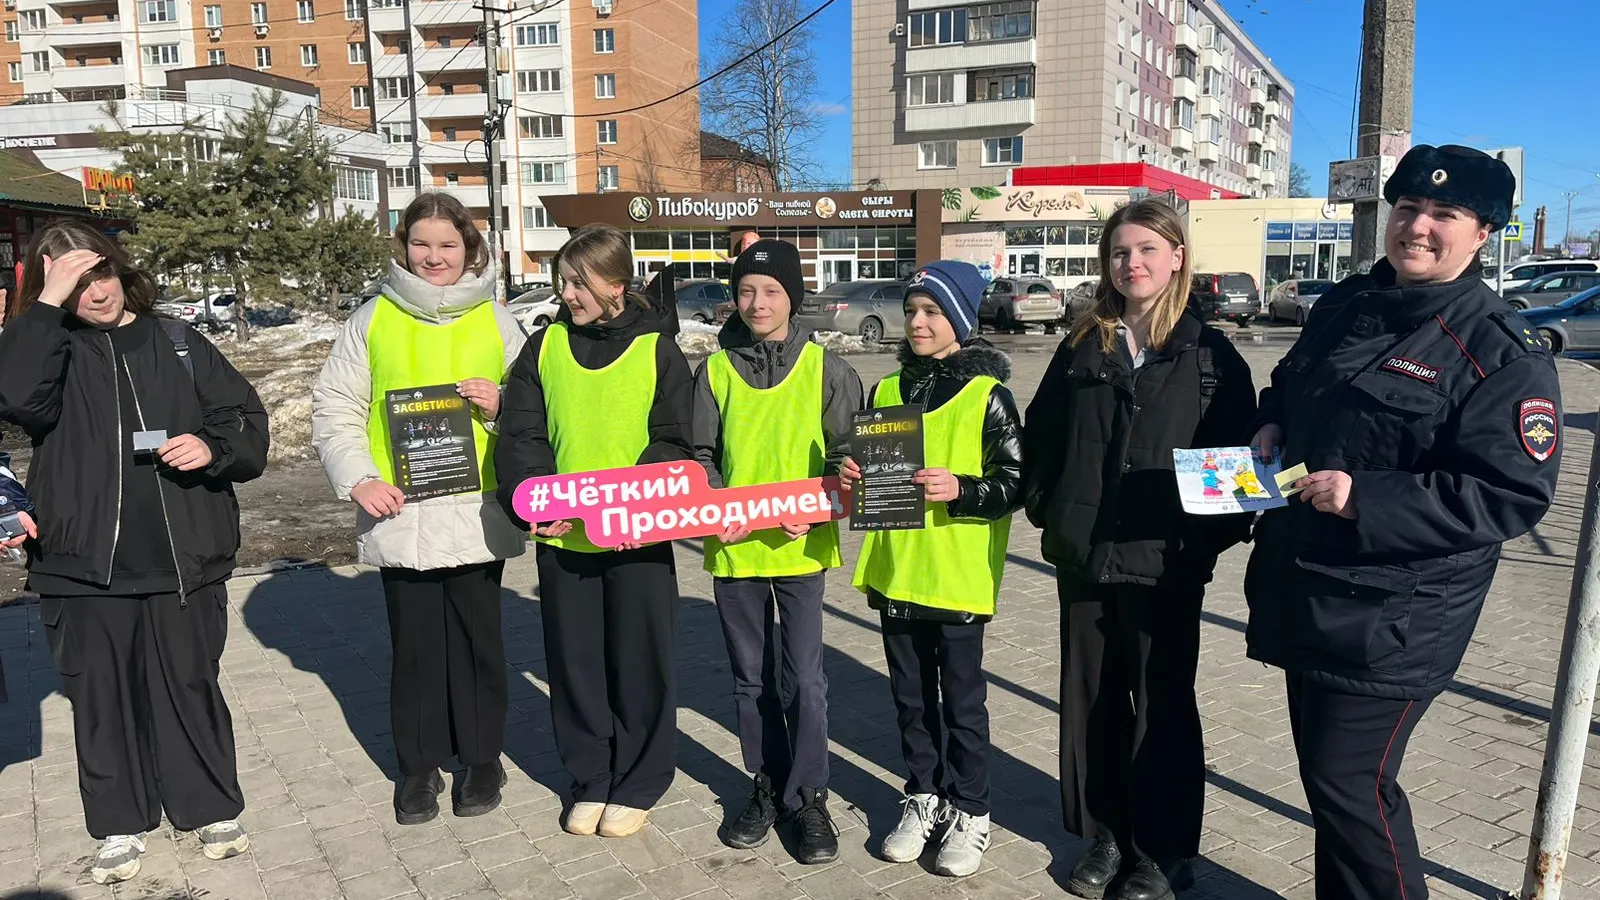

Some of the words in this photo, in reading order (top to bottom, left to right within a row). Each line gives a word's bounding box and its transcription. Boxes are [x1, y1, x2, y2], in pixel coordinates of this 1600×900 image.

[656, 197, 759, 220] Пивокуров
[862, 196, 893, 205] СЫРЫ
[839, 209, 869, 218] ОЛЕГА
[1387, 358, 1437, 379] ПОЛИЦИЯ
[1523, 400, 1553, 410] ПОЛИЦИЯ
[1524, 413, 1554, 425] РОССИЯ
[529, 465, 690, 512] #Чёткий
[601, 489, 844, 541] Проходимец
